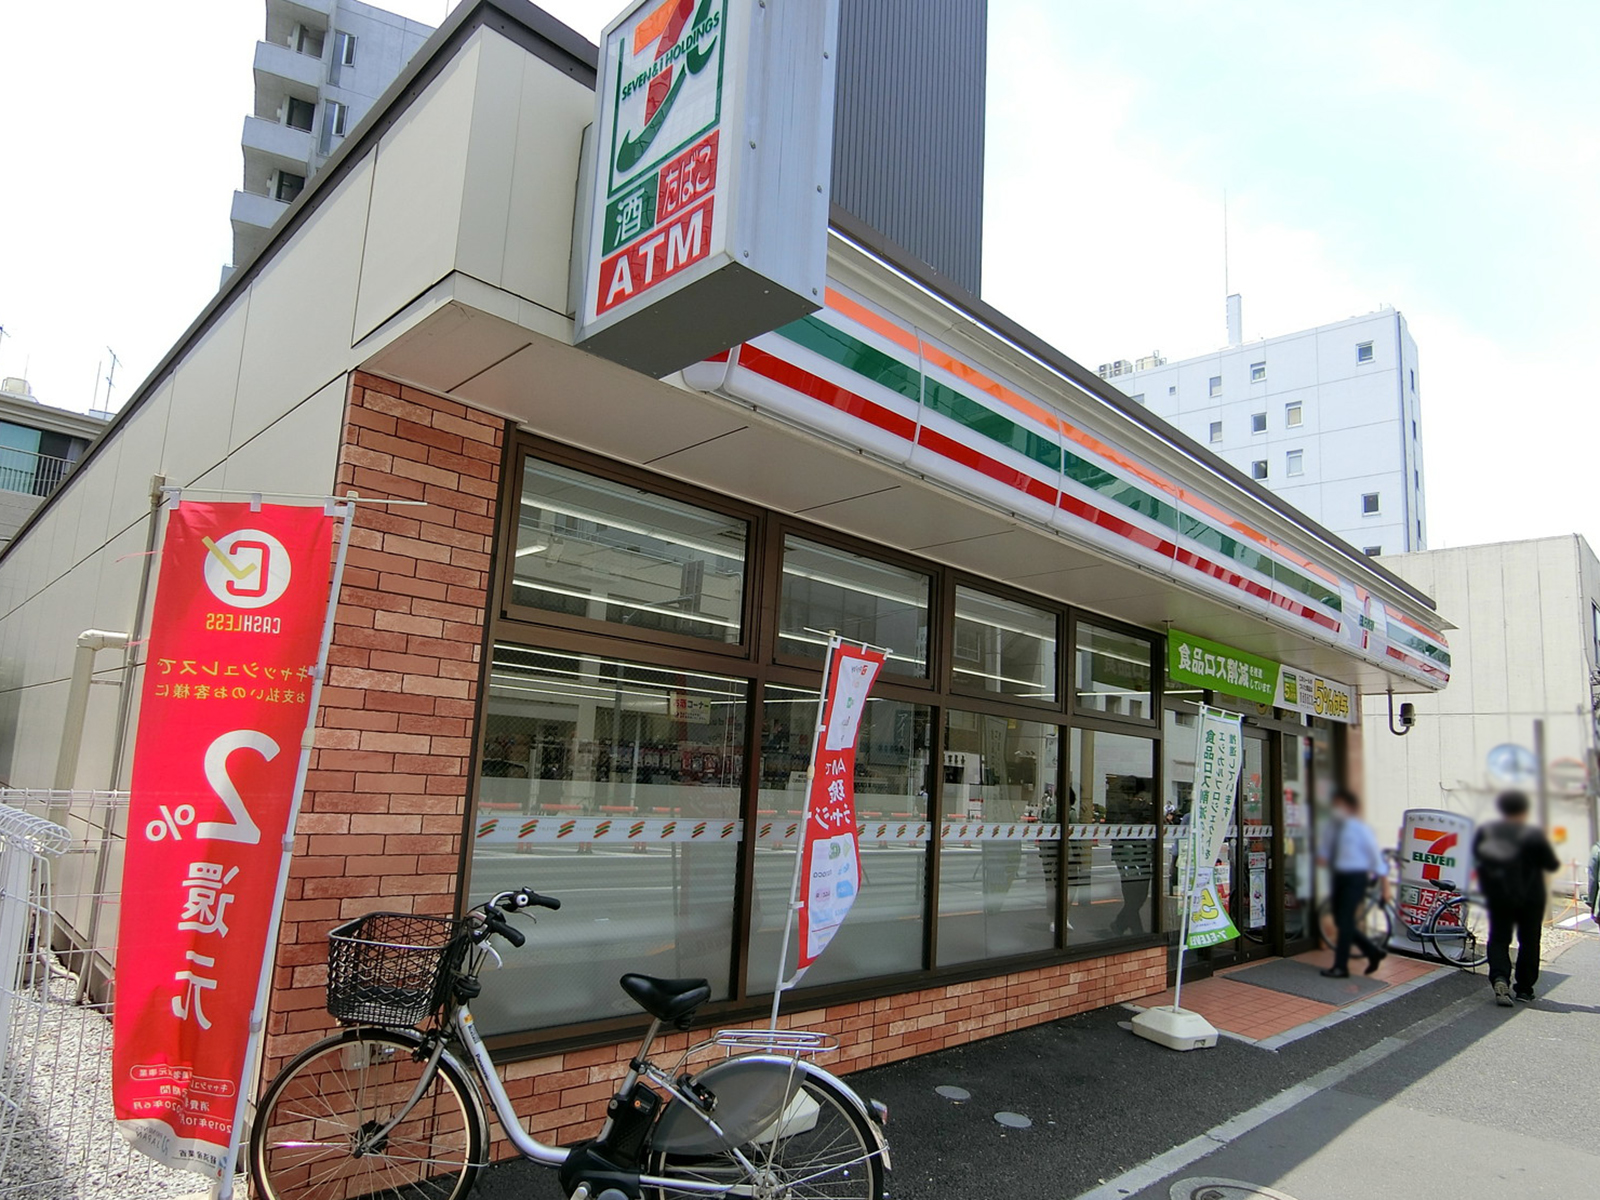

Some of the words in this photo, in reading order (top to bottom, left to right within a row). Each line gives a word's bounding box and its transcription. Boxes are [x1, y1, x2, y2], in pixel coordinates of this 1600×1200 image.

[665, 11, 720, 68] HOLDINGS
[661, 144, 713, 218] たばこ
[614, 187, 645, 248] 酒
[606, 205, 706, 307] ATM
[1178, 643, 1250, 688] 食品ロス削減
